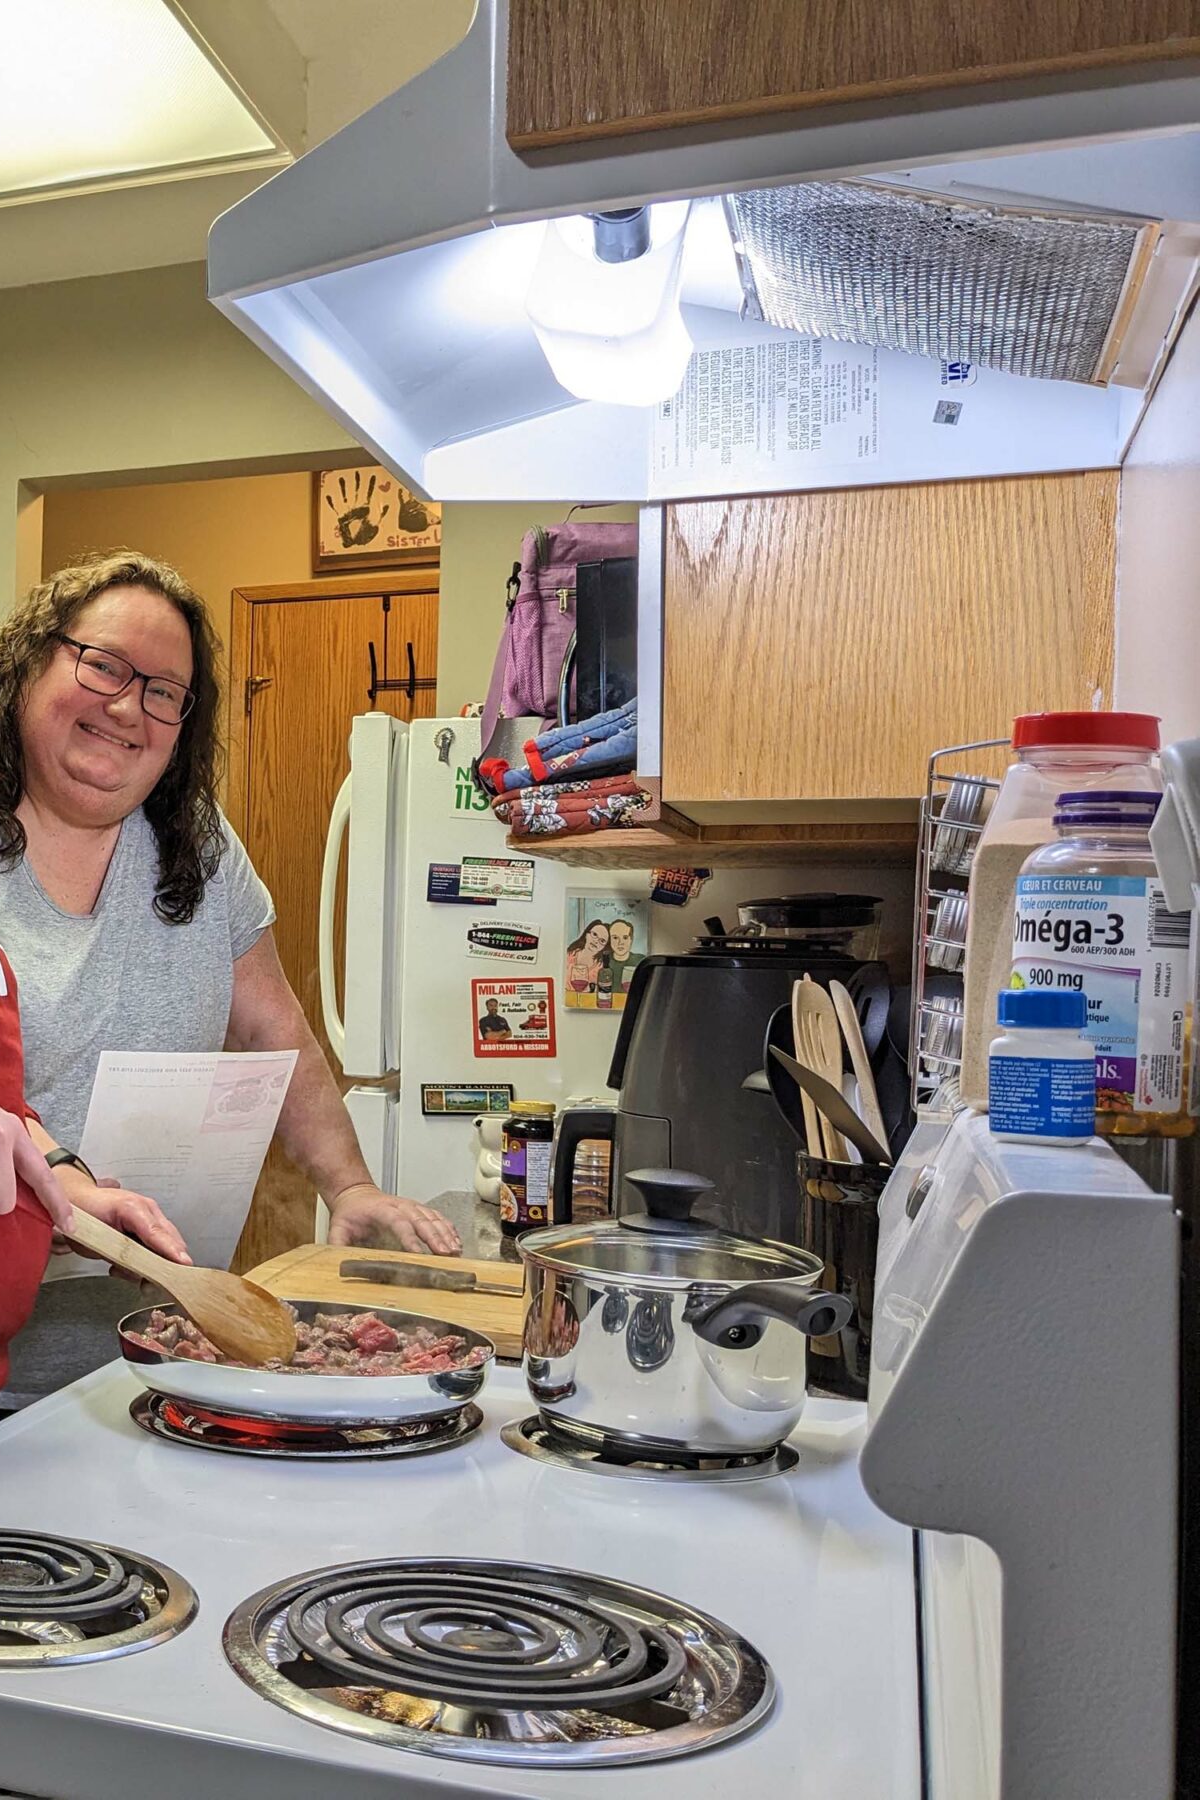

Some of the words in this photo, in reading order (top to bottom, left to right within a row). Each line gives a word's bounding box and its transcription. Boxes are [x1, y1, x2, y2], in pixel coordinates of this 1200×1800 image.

[733, 348, 742, 368] FILTRE
[799, 340, 809, 360] OTHER
[812, 339, 821, 370] WARNING
[699, 352, 708, 374] SAVON
[722, 349, 731, 384] SURFACES
[777, 343, 786, 379] DETERGENT
[699, 376, 708, 385] OU
[800, 363, 809, 389] GREASE
[733, 380, 742, 403] TOUTES
[788, 388, 797, 401] USE
[812, 377, 821, 398] CLEAN
[699, 387, 708, 423] DETERGENT
[722, 386, 731, 423] COUVERTES
[733, 405, 742, 418] LES
[788, 403, 797, 419] MILD
[800, 391, 809, 412] LADEN
[812, 401, 821, 421] FILTER
[744, 403, 754, 434] NETTOYER
[722, 426, 730, 434] DE
[732, 420, 742, 445] AUTRES
[788, 421, 797, 438] SOAP
[799, 415, 809, 450] SURFACES
[812, 424, 821, 437] AND
[745, 436, 753, 444] LE
[788, 441, 797, 450] OR
[811, 440, 820, 451] ALL
[1042, 880, 1051, 890] ET
[1053, 880, 1102, 890] CERVEAU
[1020, 898, 1035, 912] Triple
[1037, 898, 1108, 910] concentration
[1014, 910, 1124, 952] Oméga-3
[1071, 946, 1085, 954] 600
[1086, 946, 1117, 956] AEP/300
[1119, 948, 1135, 956] ADH
[1030, 968, 1053, 985] 900
[1057, 973, 1083, 991] mg
[479, 985, 516, 995] MILANI
